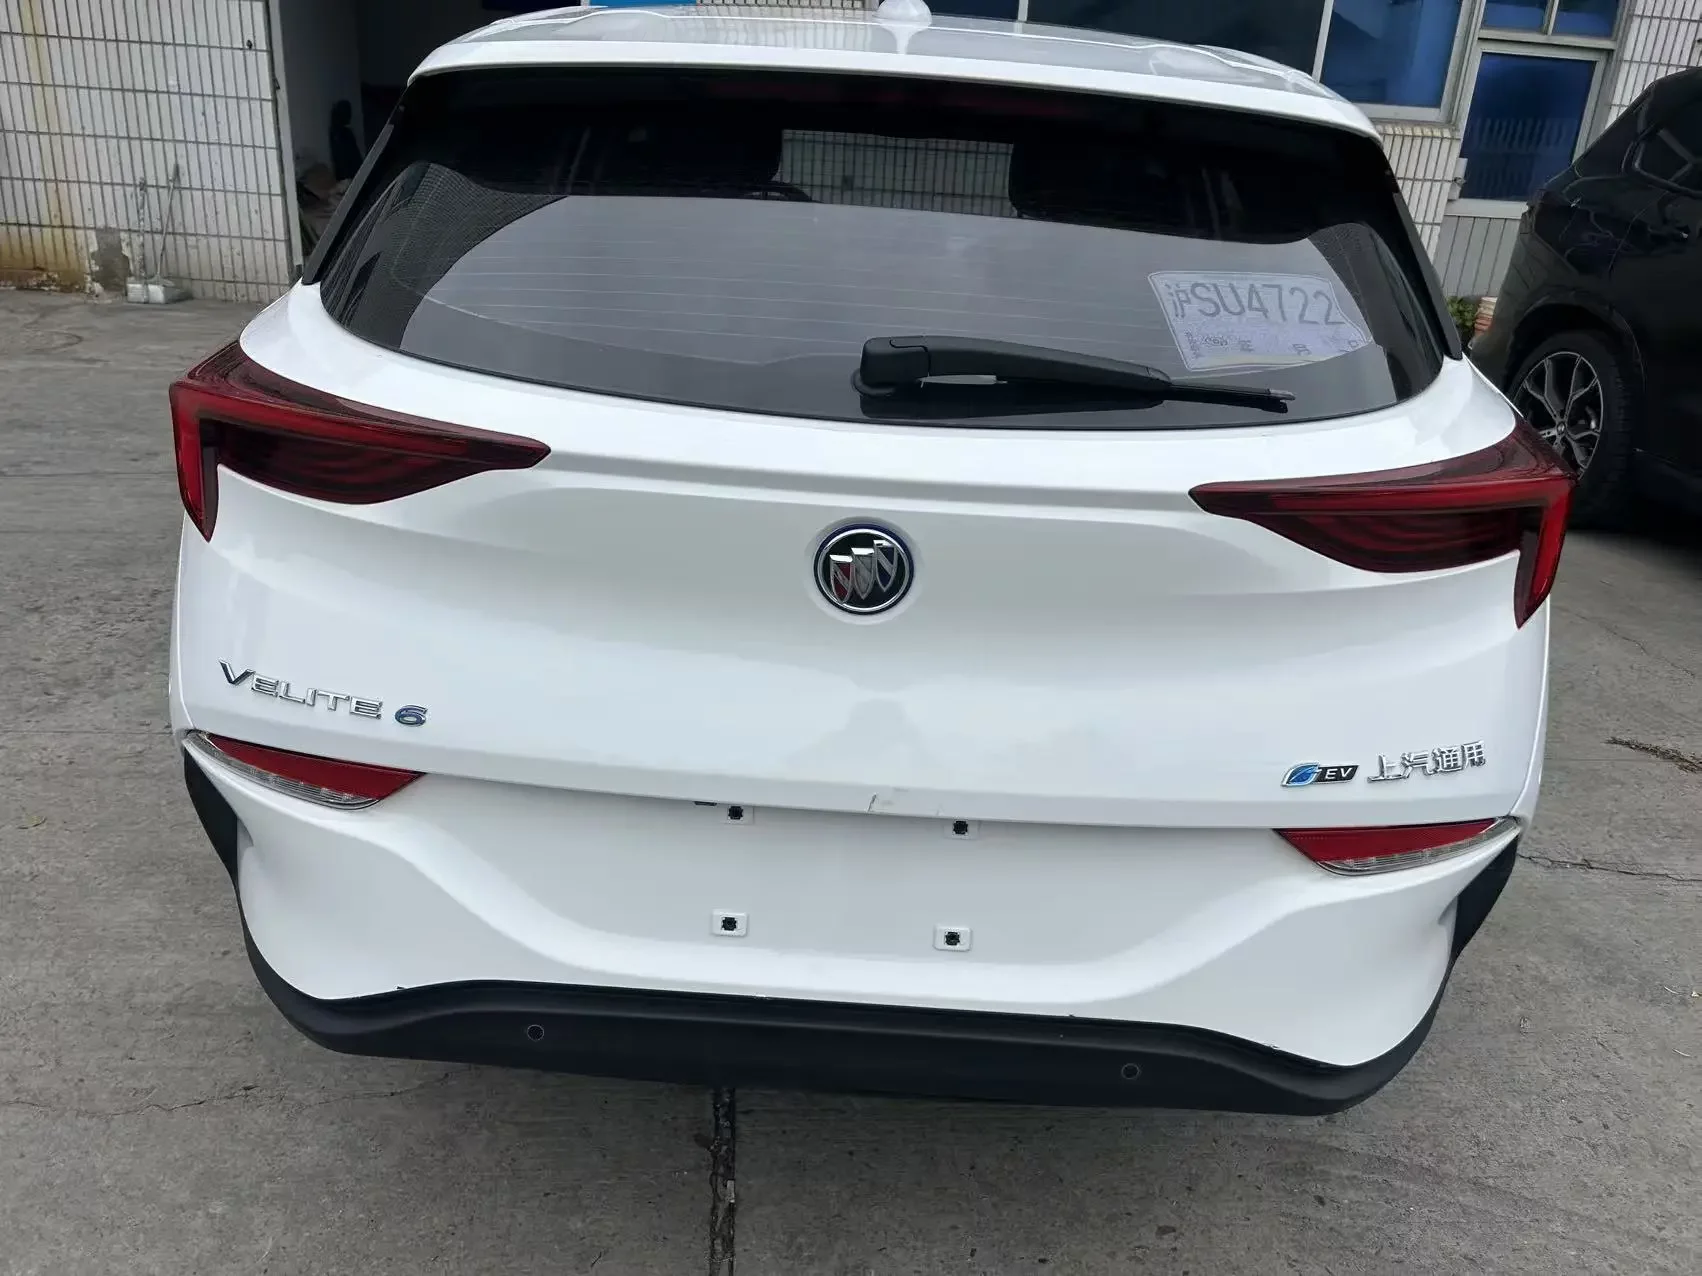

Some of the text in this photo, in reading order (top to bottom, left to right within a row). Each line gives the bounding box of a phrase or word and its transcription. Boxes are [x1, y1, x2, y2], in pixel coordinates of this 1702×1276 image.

[219, 659, 428, 727] VELITE 6
[1323, 766, 1352, 782] EV
[1367, 740, 1486, 784] 上汽通用
